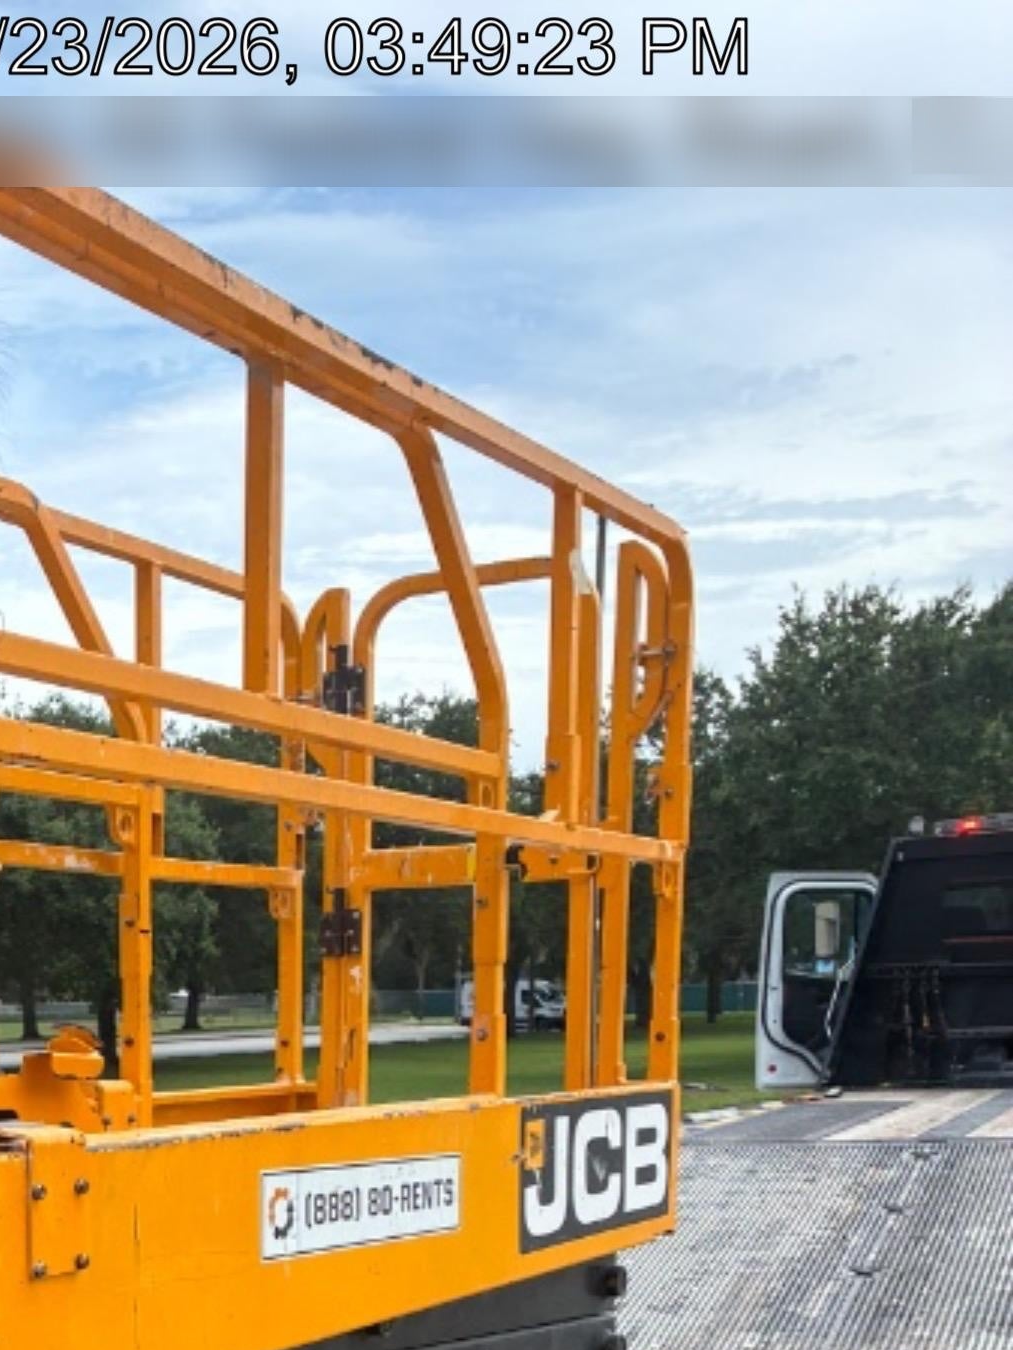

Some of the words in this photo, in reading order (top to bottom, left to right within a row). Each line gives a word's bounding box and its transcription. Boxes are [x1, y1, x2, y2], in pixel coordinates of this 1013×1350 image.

[305, 1187, 362, 1229] (888)
[367, 1178, 454, 1217] 80-RENTS
[524, 1103, 668, 1237] JCB
